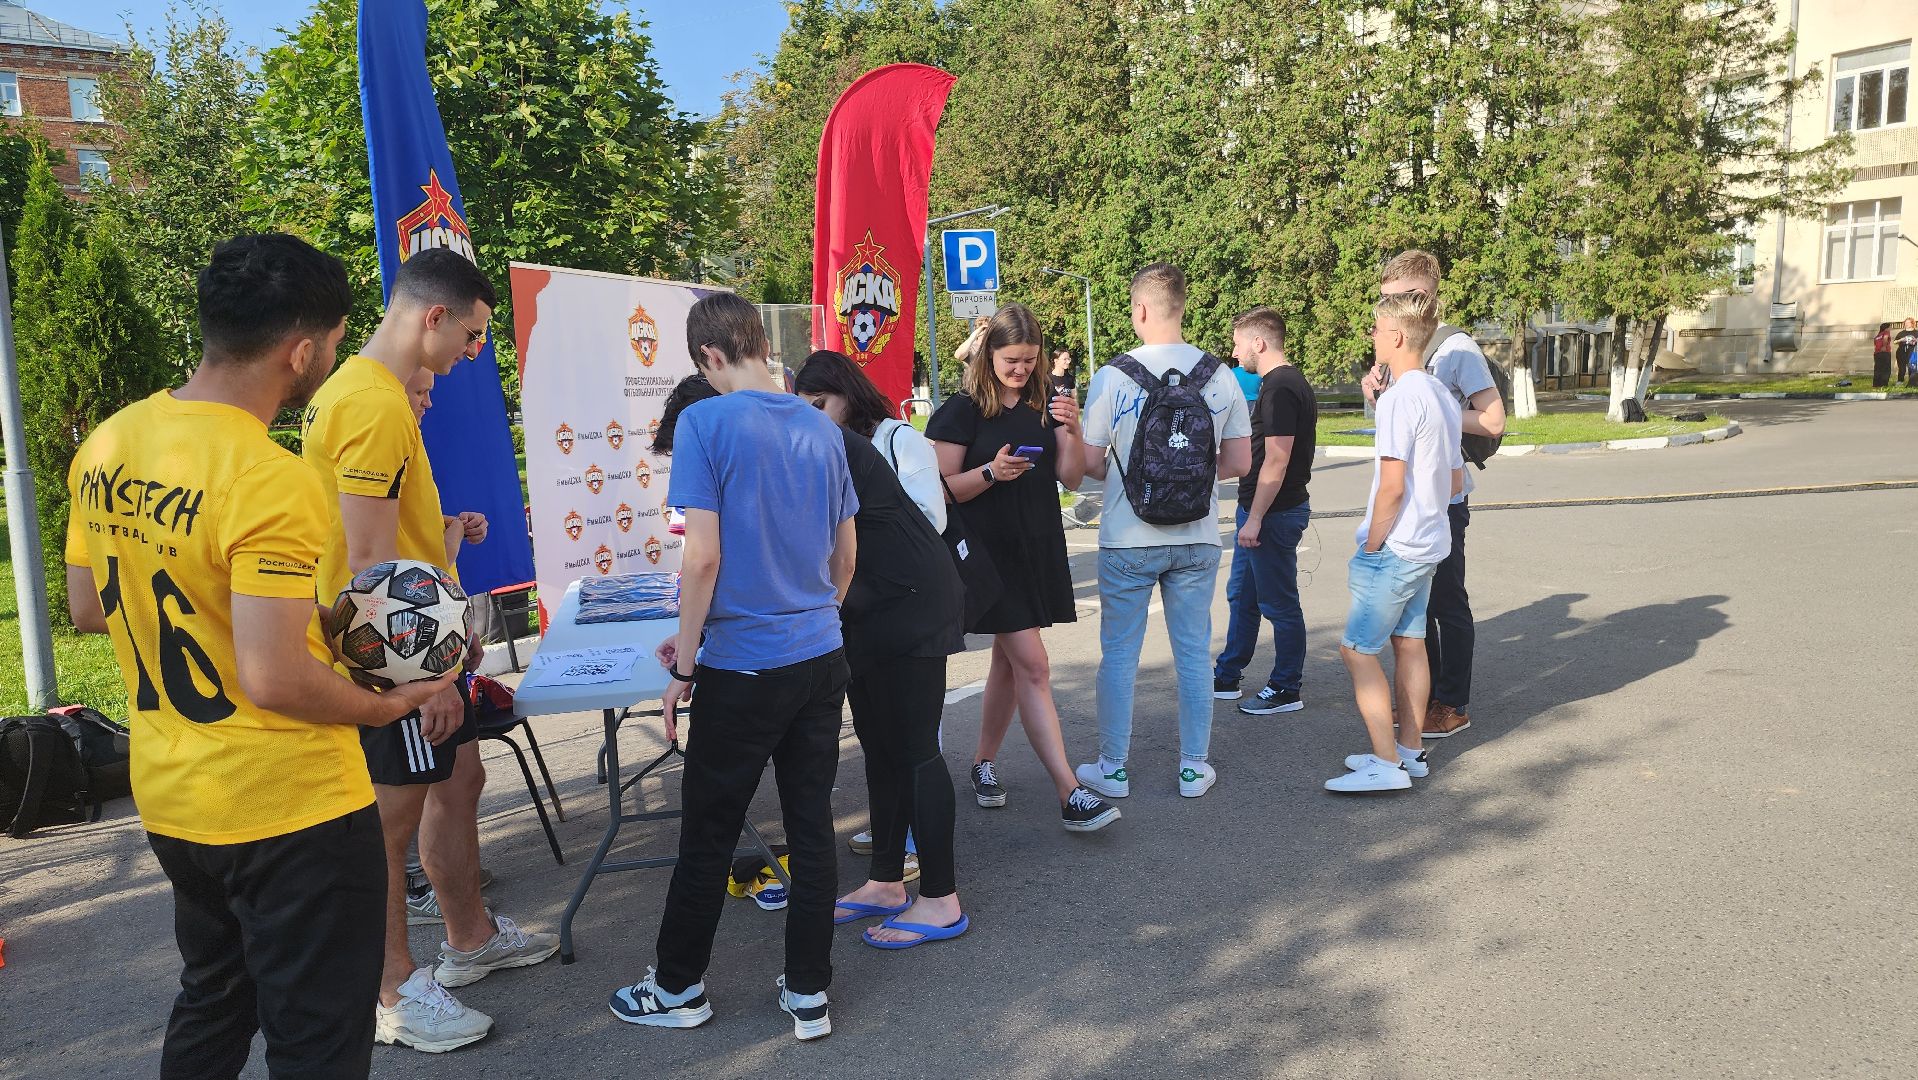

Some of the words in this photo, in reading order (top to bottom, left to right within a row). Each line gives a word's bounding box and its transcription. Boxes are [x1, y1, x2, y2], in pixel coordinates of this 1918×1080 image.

[958, 237, 988, 285] P
[954, 295, 994, 303] ПАРКОВКА
[1168, 440, 1189, 449] Kappa
[80, 463, 203, 536] PHYSTECH
[100, 555, 238, 724] 16
